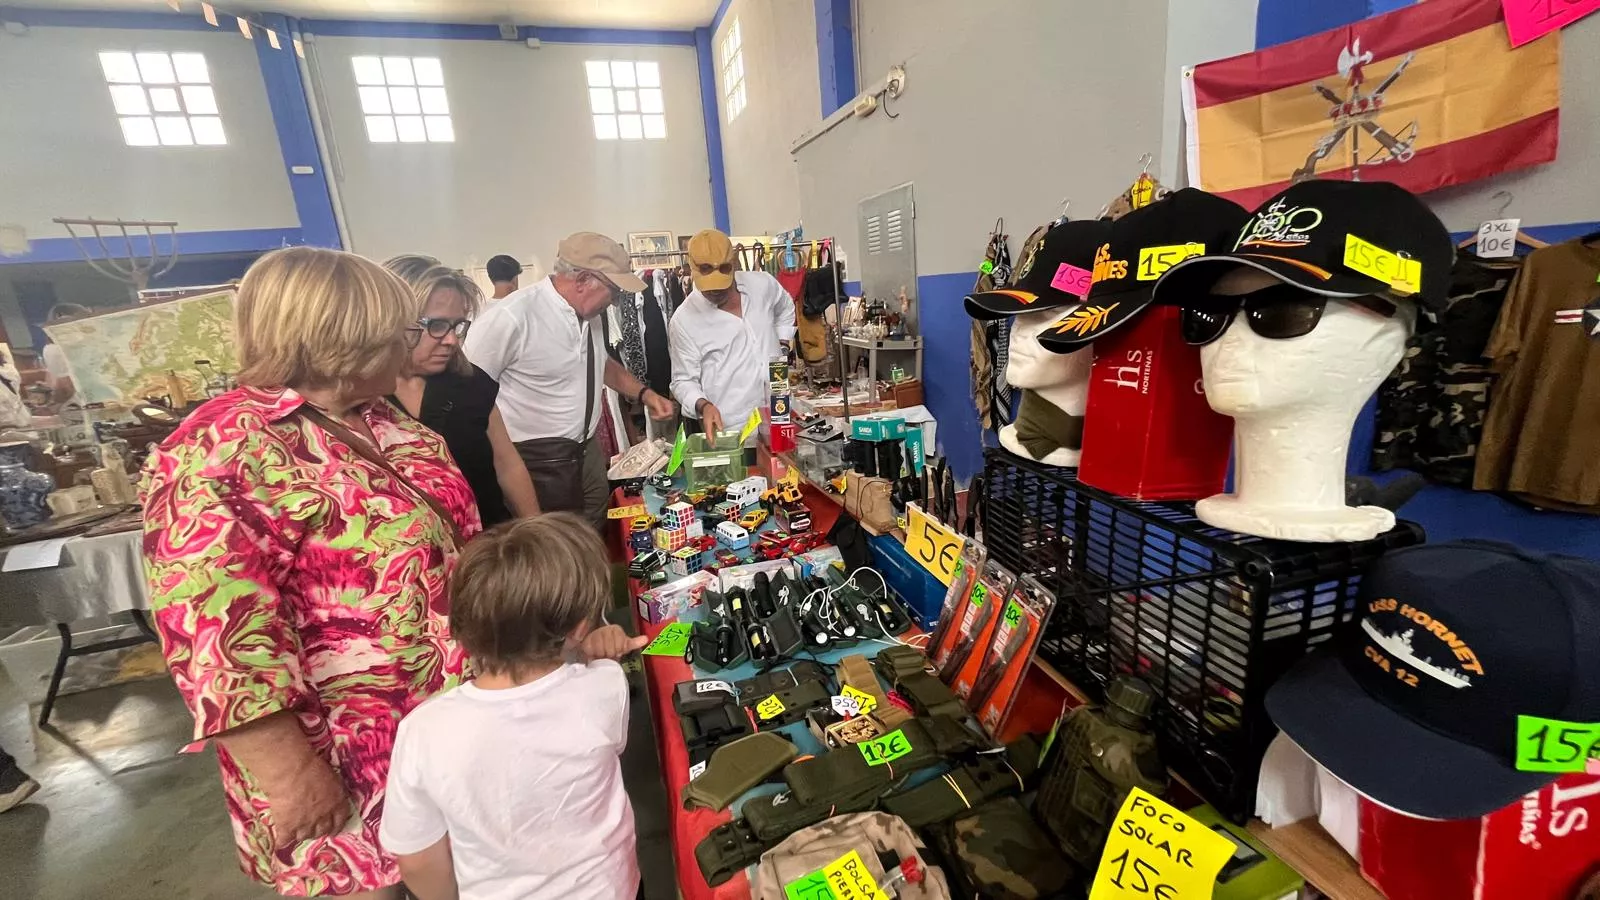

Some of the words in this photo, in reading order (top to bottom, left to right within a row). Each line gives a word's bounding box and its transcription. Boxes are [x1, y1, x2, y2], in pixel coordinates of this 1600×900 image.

[1349, 242, 1389, 274] 15€
[1479, 238, 1513, 254] 10€
[919, 521, 959, 575] 5€
[971, 584, 985, 603] 10€
[1006, 605, 1020, 625] 10€
[1368, 598, 1398, 613] USS
[1399, 603, 1485, 676] HORNET
[1364, 645, 1391, 673] CVA
[1395, 668, 1419, 688] 12
[698, 682, 723, 691] 12€
[761, 699, 785, 715] 12€
[864, 735, 906, 763] 12€
[1130, 796, 1186, 832] FOCO
[1118, 819, 1194, 868] SOLAR
[842, 858, 877, 900] BOLSA
